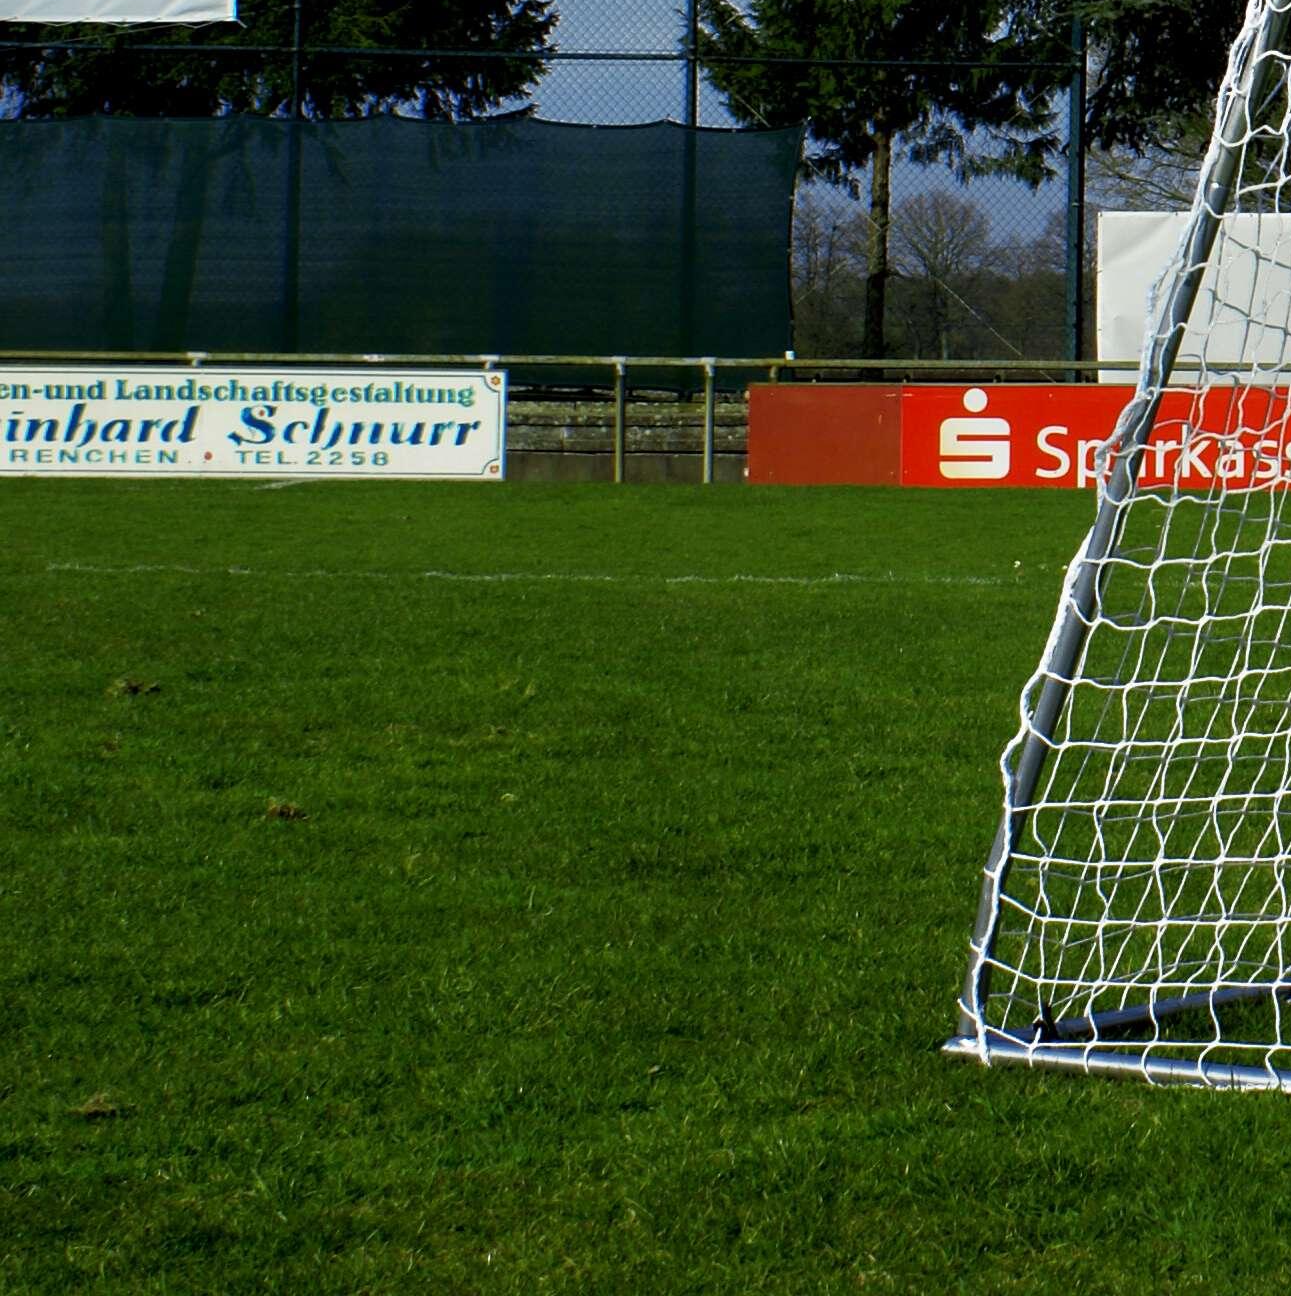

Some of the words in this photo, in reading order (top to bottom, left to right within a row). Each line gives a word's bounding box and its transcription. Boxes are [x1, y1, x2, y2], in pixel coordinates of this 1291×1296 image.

[115, 379, 475, 406] Landschaftsgestaltung
[227, 404, 481, 450] Schnurr
[10, 449, 178, 463] RENCHEN
[235, 450, 297, 465] TEL.
[306, 450, 389, 465] 2258
